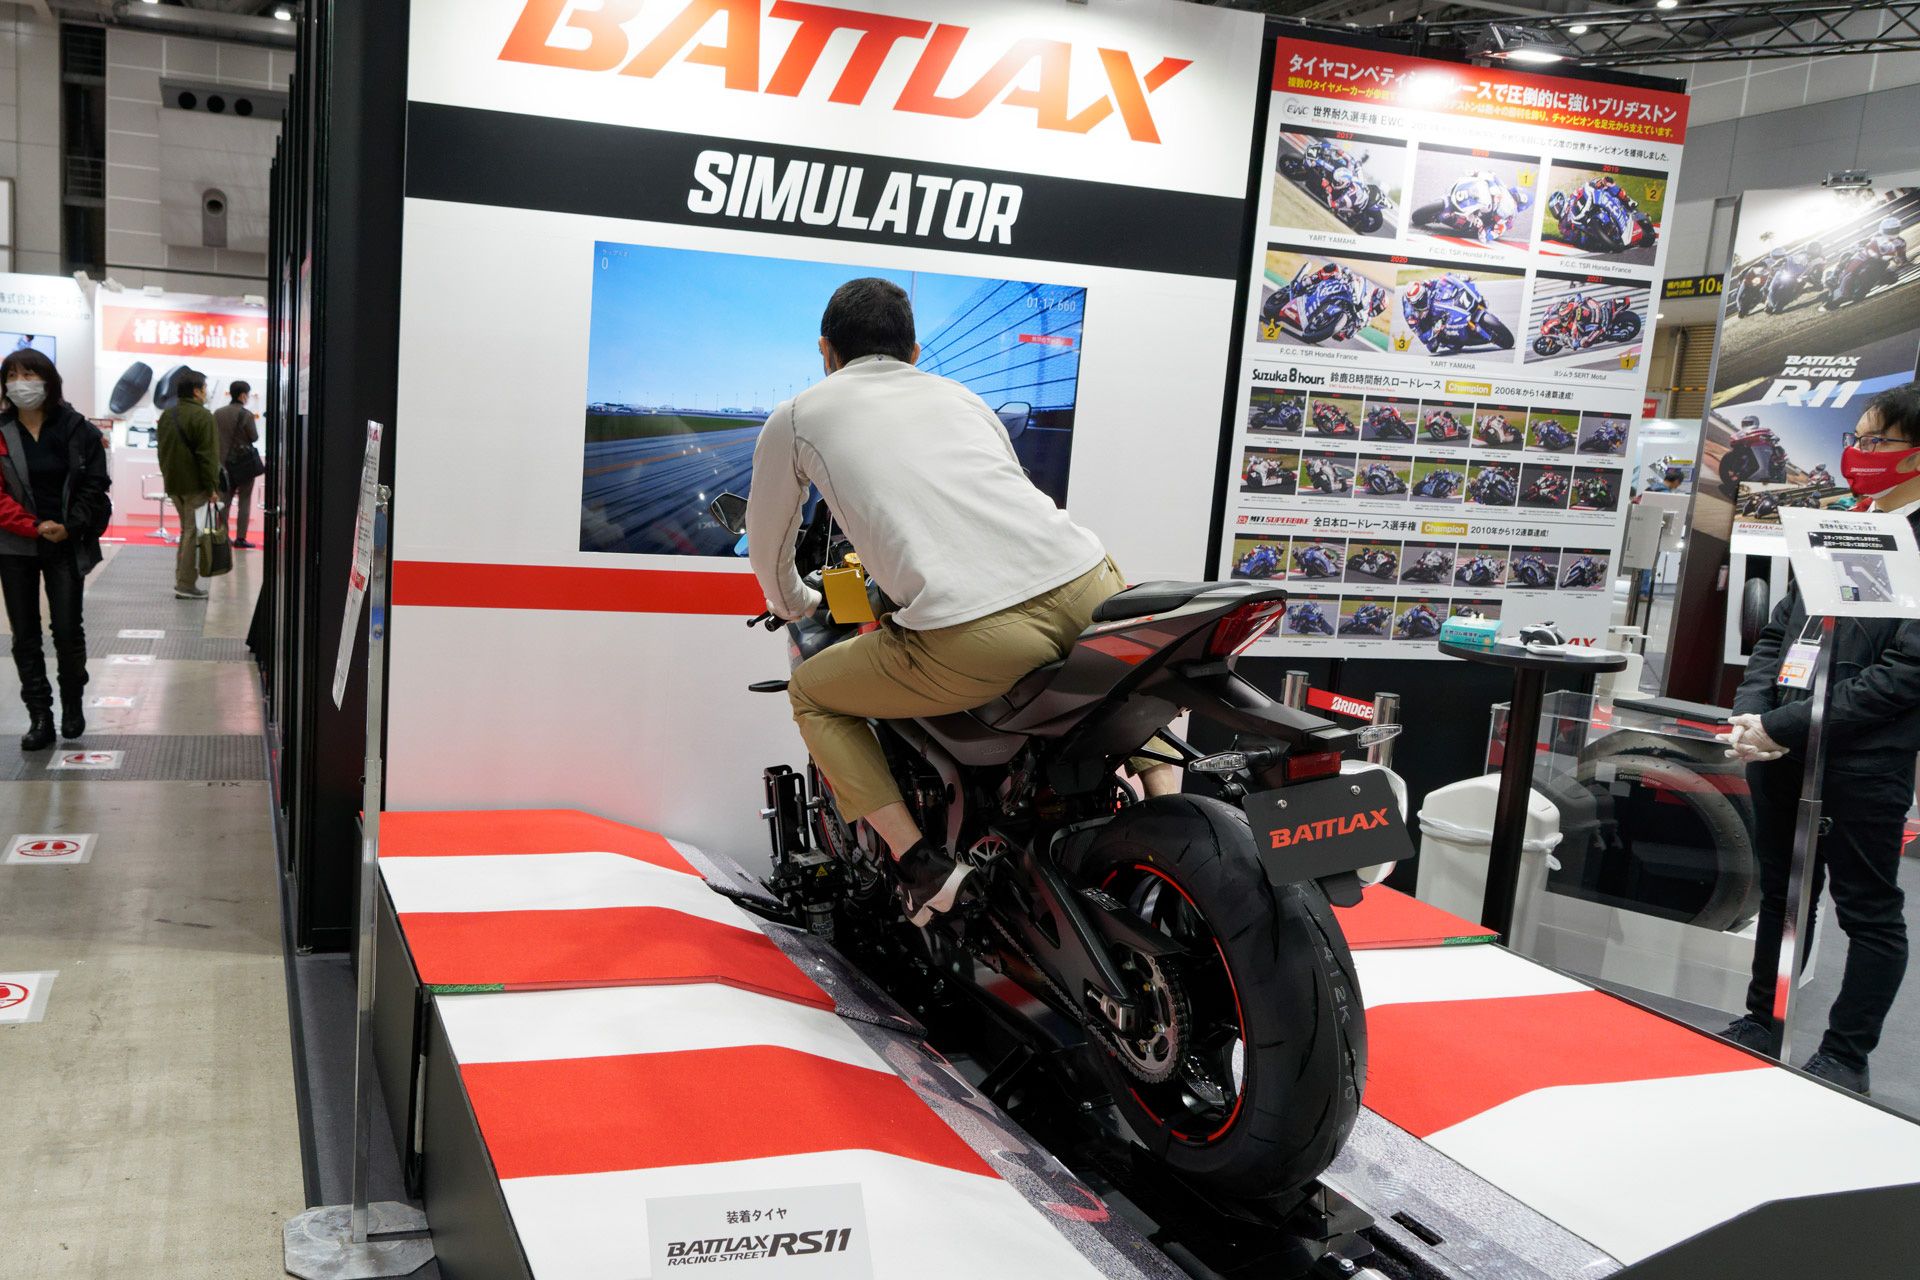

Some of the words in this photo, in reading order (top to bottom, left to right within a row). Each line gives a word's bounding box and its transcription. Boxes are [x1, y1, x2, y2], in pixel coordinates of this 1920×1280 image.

[497, 0, 1194, 145] BATTLAX
[1313, 105, 1377, 125] 世界耐久選手権
[1380, 115, 1404, 128] EWC
[1336, 131, 1354, 140] 2017
[1602, 164, 1619, 173] 2019
[1524, 174, 1528, 184] 1
[687, 150, 1023, 246] SIMULATOR
[1650, 189, 1656, 199] 2
[1309, 234, 1327, 242] YART
[1328, 237, 1357, 245] YAMAHA
[1390, 255, 1408, 264] 2020
[1462, 250, 1482, 258] Honda
[1483, 252, 1505, 261] France
[601, 257, 608, 270] 0
[1592, 263, 1611, 272] Honda
[1612, 265, 1632, 274] France
[1587, 275, 1603, 283] 2021
[1026, 296, 1076, 312] 01:17.660
[1268, 328, 1275, 337] 2
[1399, 339, 1405, 348] 3
[1300, 349, 1313, 357] TSR
[1314, 350, 1335, 359] Honda
[1336, 352, 1358, 361] France
[1784, 355, 1861, 367] BATTLAX
[1449, 362, 1476, 370] YAMAHA
[1626, 358, 1630, 367] 1
[1252, 369, 1288, 383] Suzuka
[1288, 367, 1297, 383] 8
[1298, 372, 1325, 385] hours
[1554, 370, 1573, 378] ヨシムラ
[1591, 373, 1607, 381] Motul
[1781, 366, 1856, 378] RACING
[1330, 372, 1441, 390] 鈴鹿8時間耐久ロードレース
[1447, 382, 1489, 395] Champion
[1758, 378, 1863, 408] R11
[1266, 516, 1309, 525] SUPERBIKE
[1313, 517, 1417, 531] 全日本ロードレース選手権
[1424, 523, 1465, 534] Champion
[1269, 807, 1390, 849] BATTLAX
[726, 1207, 787, 1224] 装着タイヤ
[667, 1234, 770, 1258] BATTLAX
[767, 1228, 852, 1258] RS11
[667, 1255, 717, 1266] RACING
[719, 1251, 768, 1262] STREET
